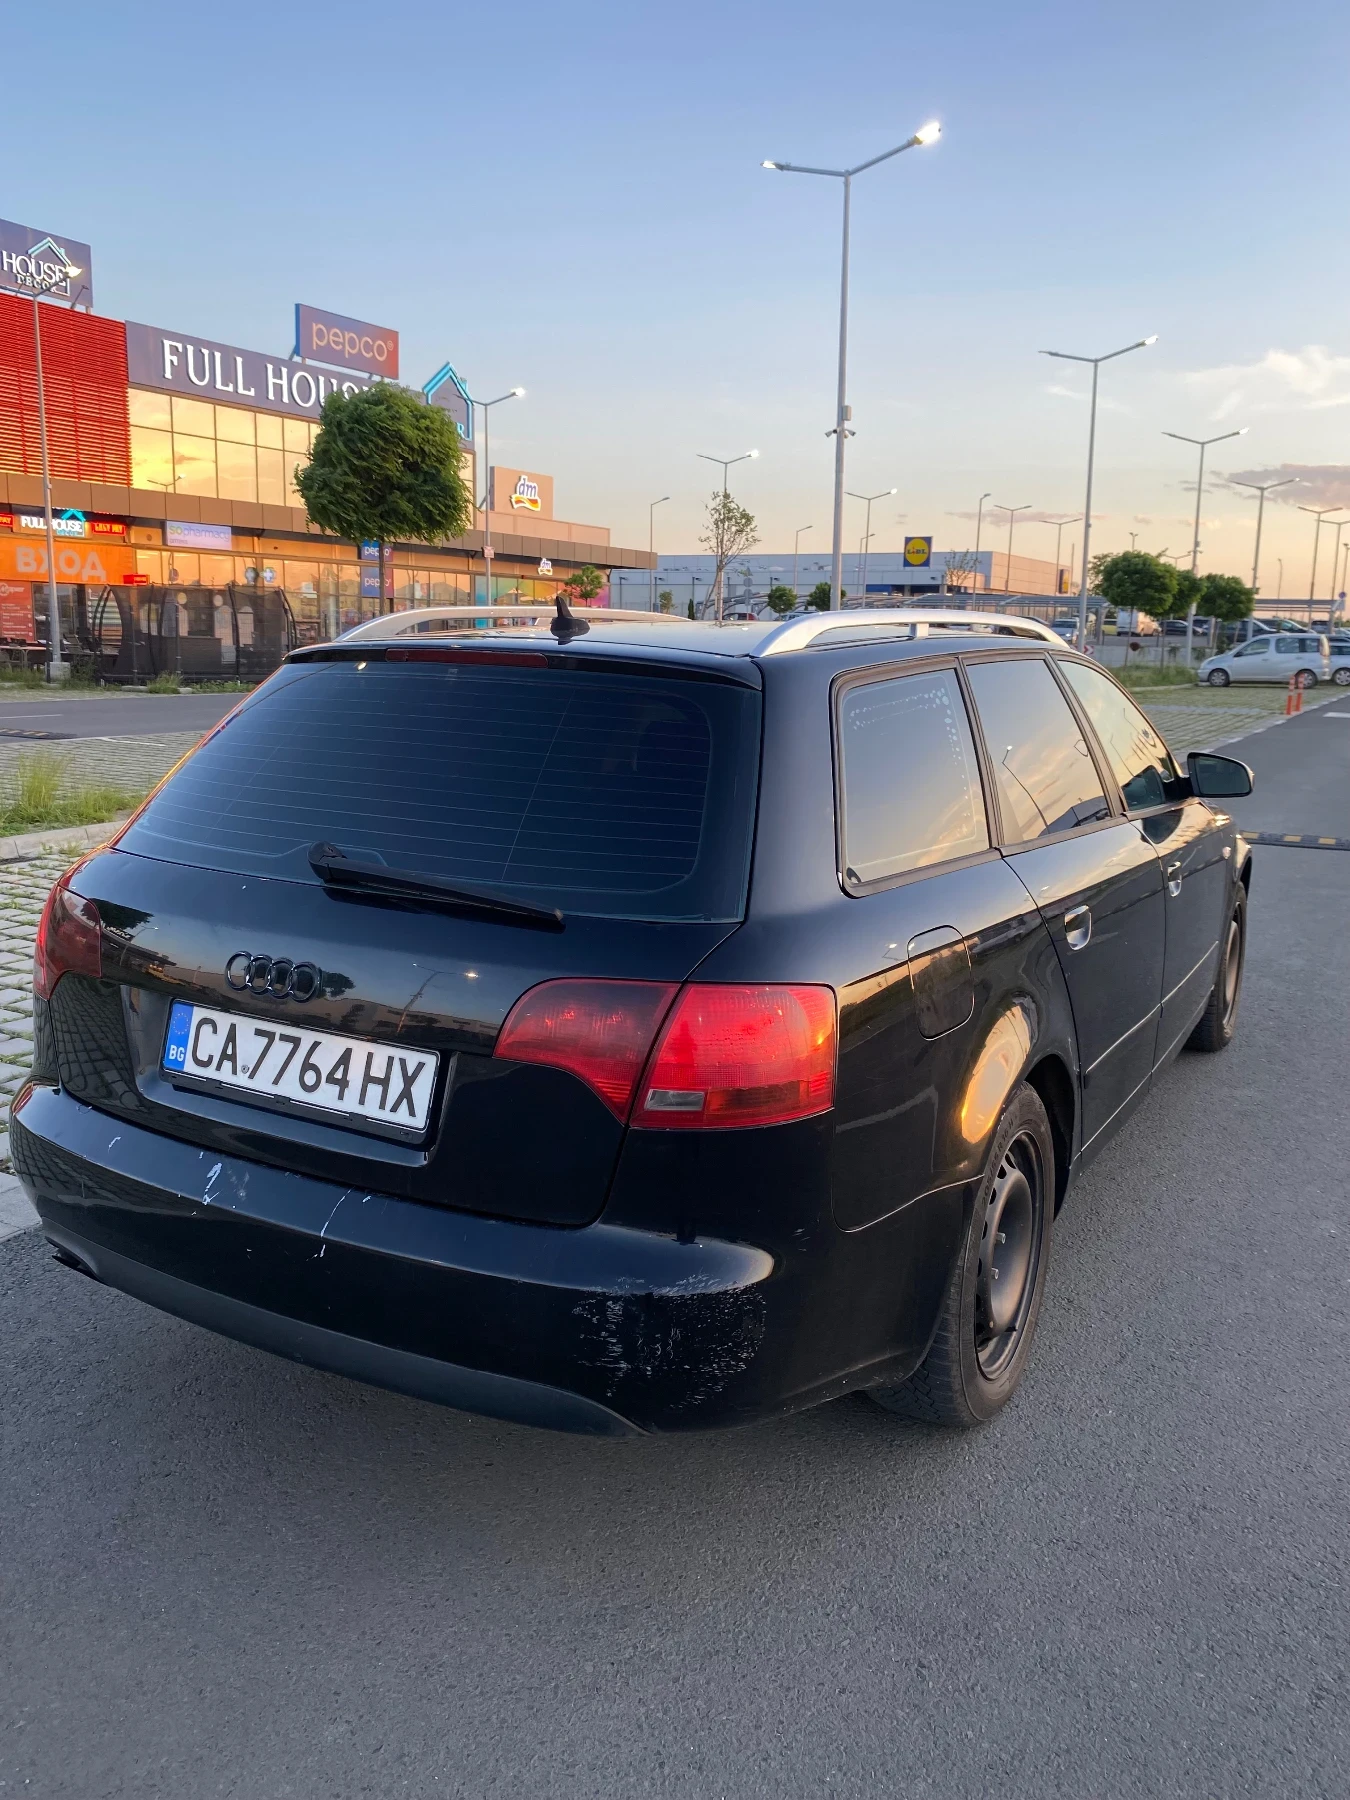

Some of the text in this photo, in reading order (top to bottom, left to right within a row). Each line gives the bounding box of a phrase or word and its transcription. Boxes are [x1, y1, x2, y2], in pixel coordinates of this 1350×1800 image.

[2, 250, 67, 287] HOUSE
[162, 338, 376, 408] FULL HOU
[518, 476, 537, 498] dm
[20, 515, 47, 530] FULL
[364, 546, 390, 557] pepo
[364, 577, 390, 588] pepo
[168, 1044, 185, 1063] BG
